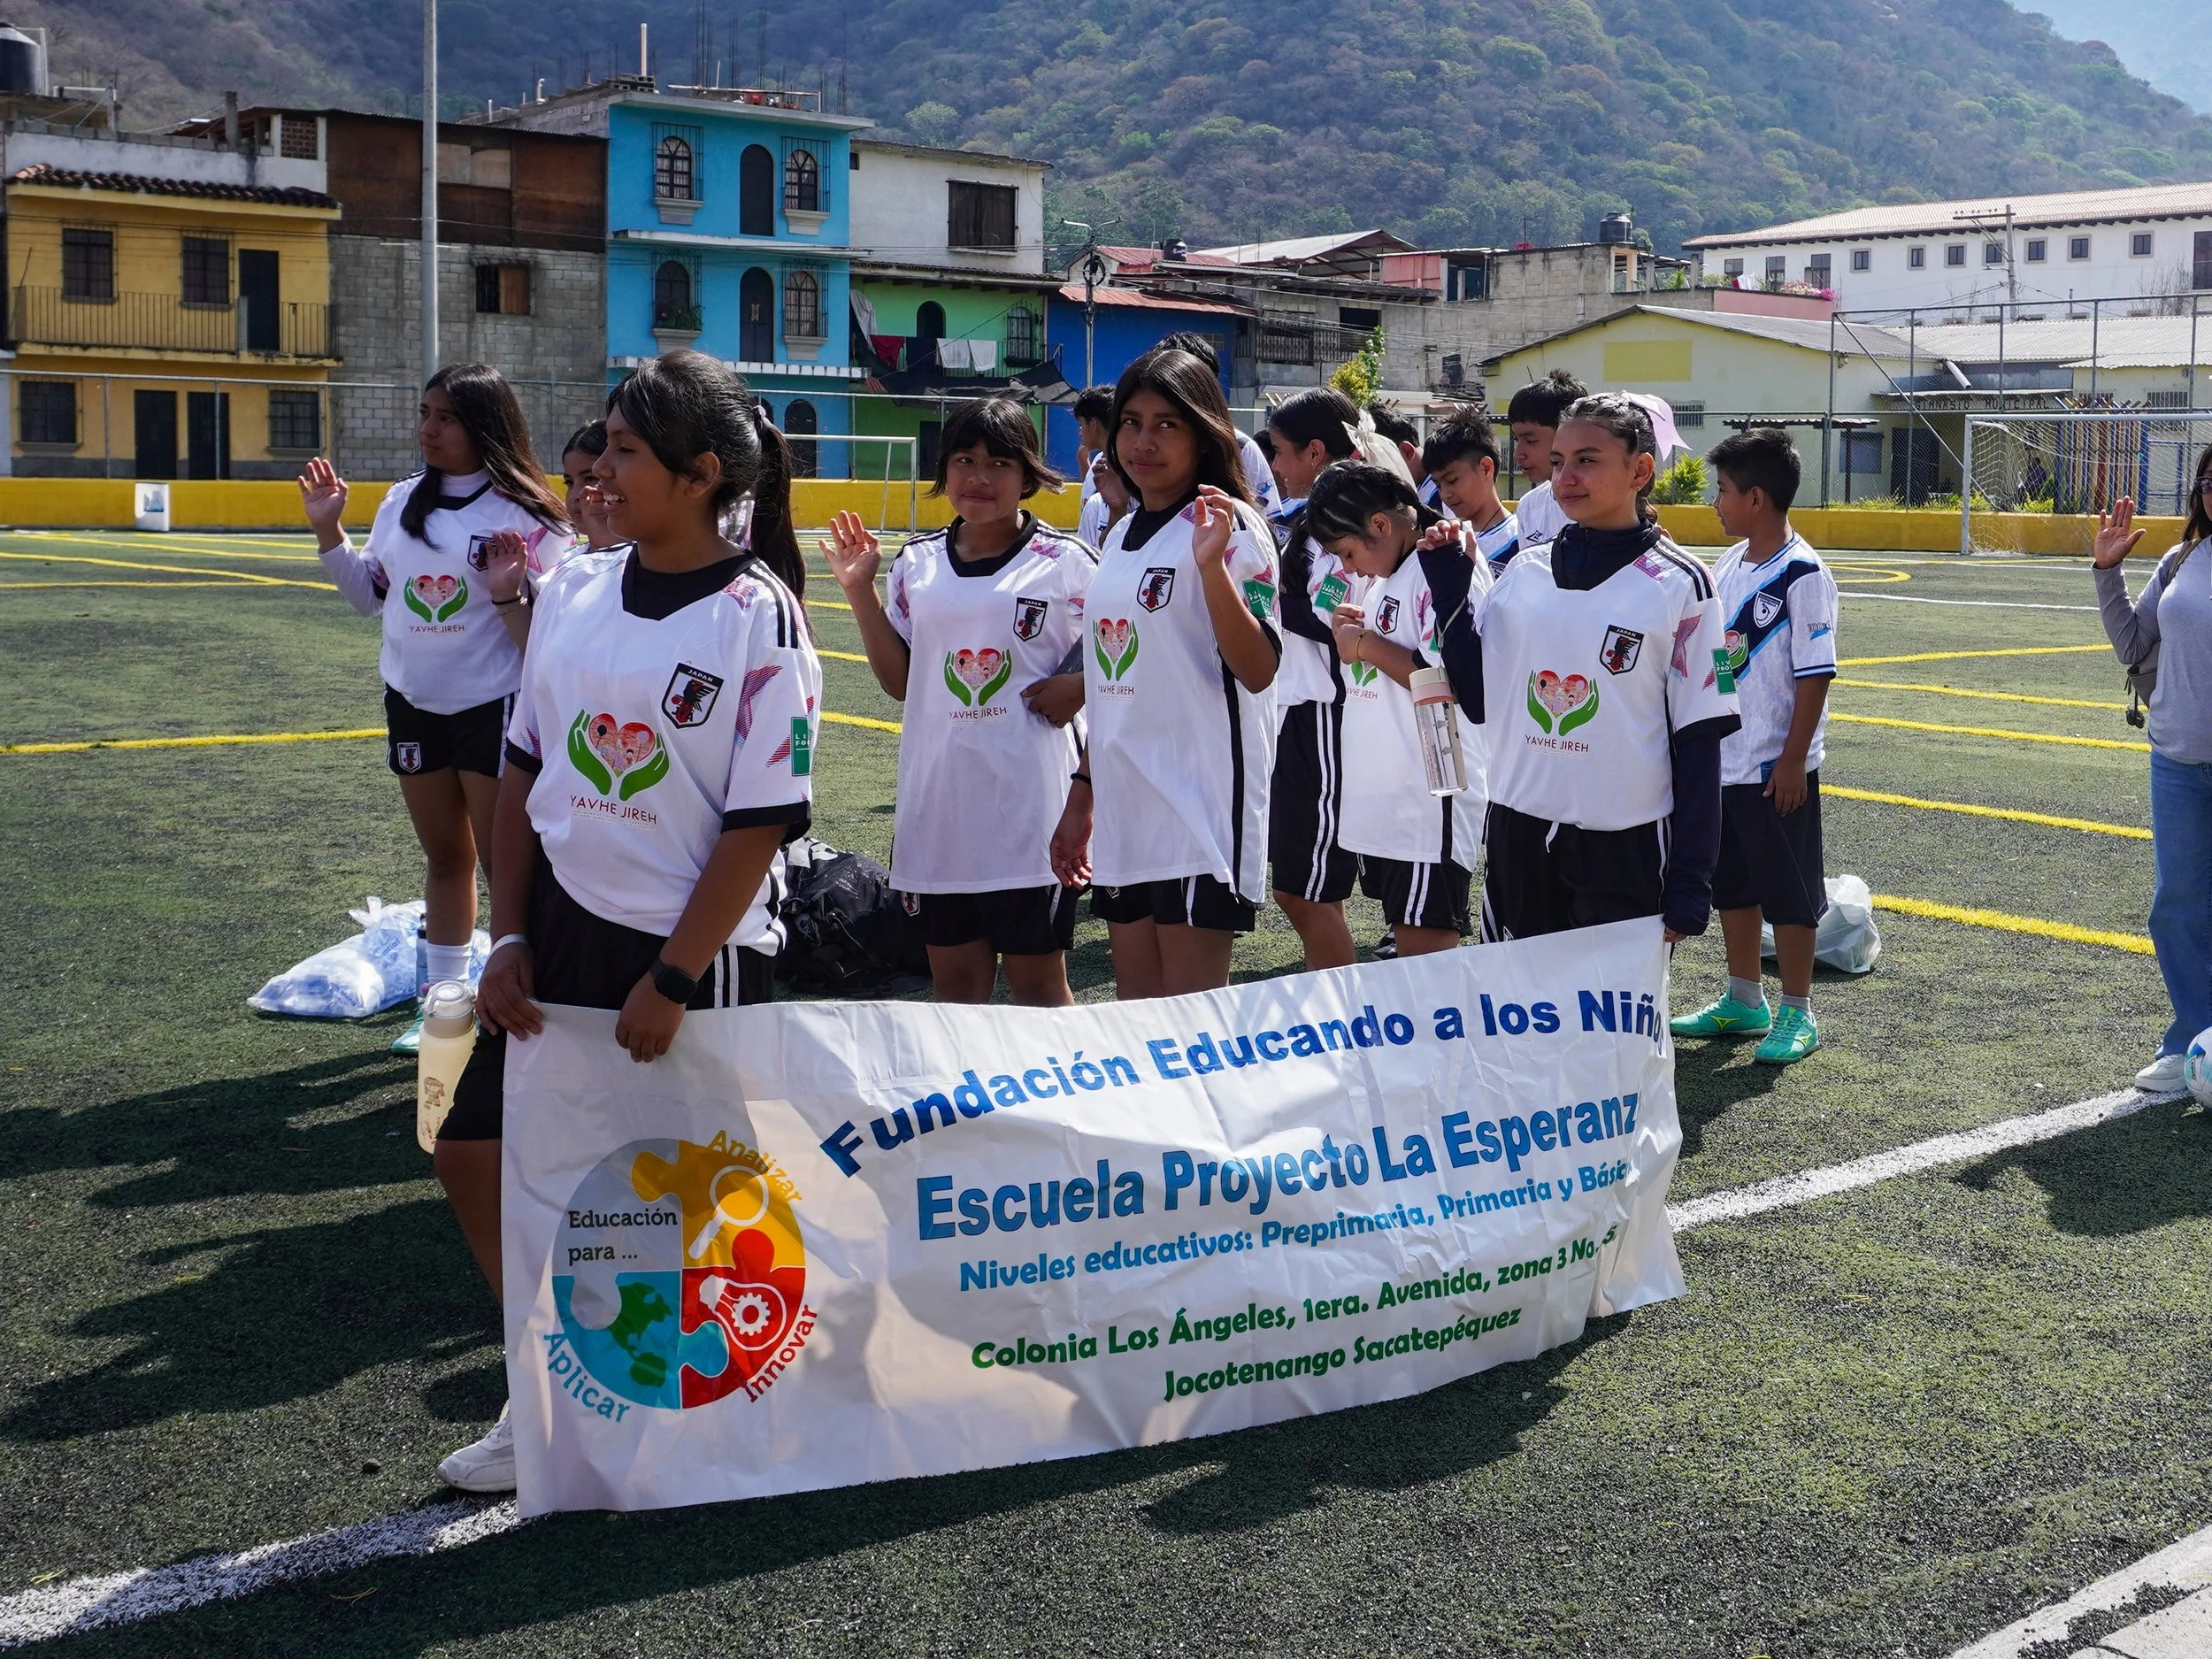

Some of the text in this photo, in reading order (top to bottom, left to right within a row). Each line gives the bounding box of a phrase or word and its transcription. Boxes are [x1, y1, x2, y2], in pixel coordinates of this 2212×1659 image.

[409, 624, 465, 634] YAVHE JIREH
[1616, 628, 1637, 638] JAPAN
[687, 669, 713, 682] JAPAN
[949, 706, 1008, 719] YAVHE JIREH
[1525, 734, 1557, 749] YAVHE
[1560, 740, 1589, 753] JIREH
[570, 795, 618, 815] YAVHE
[621, 806, 657, 825] JIREH
[819, 1052, 1141, 1178] Fundación
[1147, 1005, 1415, 1079] Educando
[1433, 1007, 1466, 1041] a
[1480, 994, 1562, 1036] los
[708, 1129, 803, 1204] Analizar
[917, 1093, 1639, 1241] Escuela Proyecto La Esperanz
[567, 1206, 678, 1230] Educación
[960, 1253, 1076, 1293] Niveles
[1085, 1231, 1255, 1275] educativos:
[1261, 1202, 1436, 1248] Preprimaria,
[1437, 1179, 1553, 1221] Primaria
[1557, 1178, 1575, 1203] y
[567, 1242, 617, 1266] para
[972, 1333, 1098, 1370] Colonia
[1109, 1325, 1160, 1355] Los
[1168, 1303, 1296, 1346] Ángeles,
[1302, 1294, 1371, 1324] 1era.
[1377, 1266, 1491, 1310] Avenida,
[1497, 1256, 1554, 1286] zona
[1557, 1247, 1567, 1270] 3
[1570, 1237, 1600, 1263] No.
[542, 1332, 631, 1423] Aplicar
[745, 1303, 818, 1402] Innovar
[1164, 1308, 1522, 1403] Jocotenango Sacatepéquez
